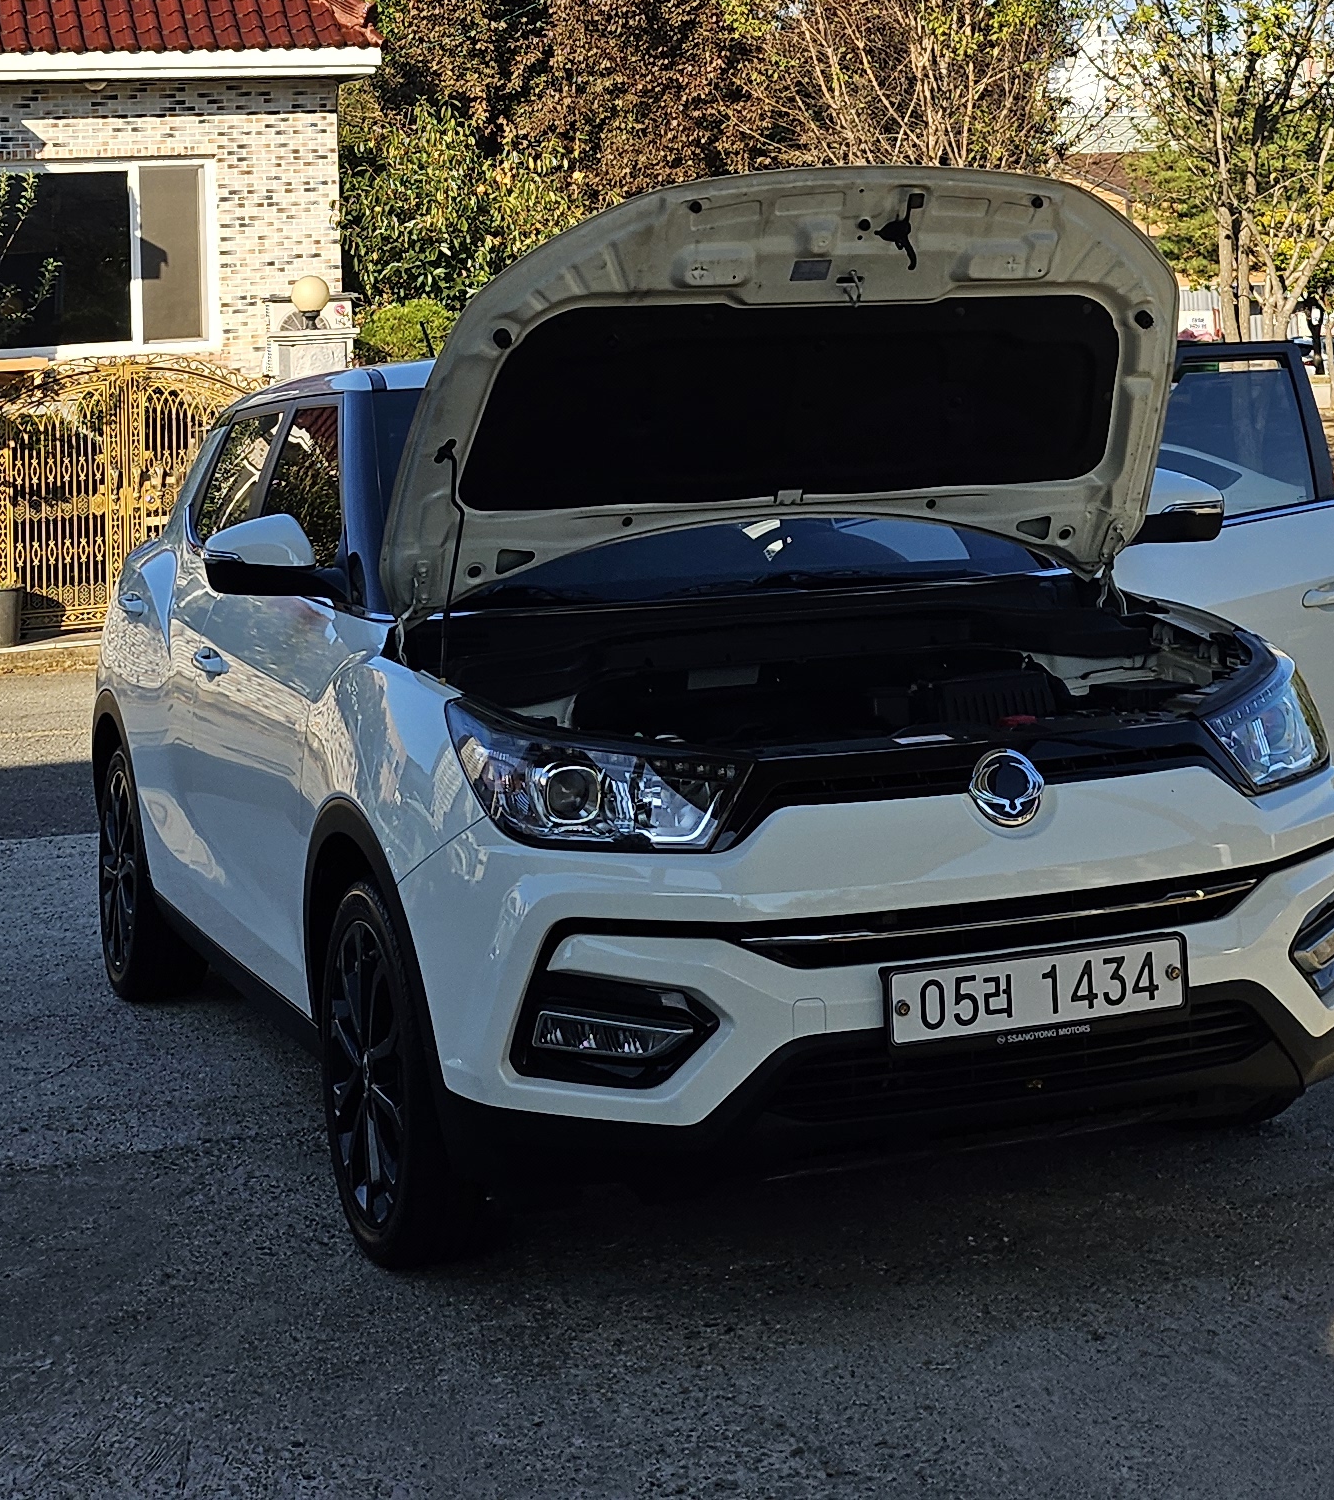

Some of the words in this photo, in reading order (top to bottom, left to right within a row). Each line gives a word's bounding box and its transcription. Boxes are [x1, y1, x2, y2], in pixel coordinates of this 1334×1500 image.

[919, 973, 1013, 1031] 05러
[1041, 951, 1160, 1015] 1434
[1007, 1029, 1057, 1043] SSANGYONG
[1058, 1025, 1091, 1036] MOTORS
